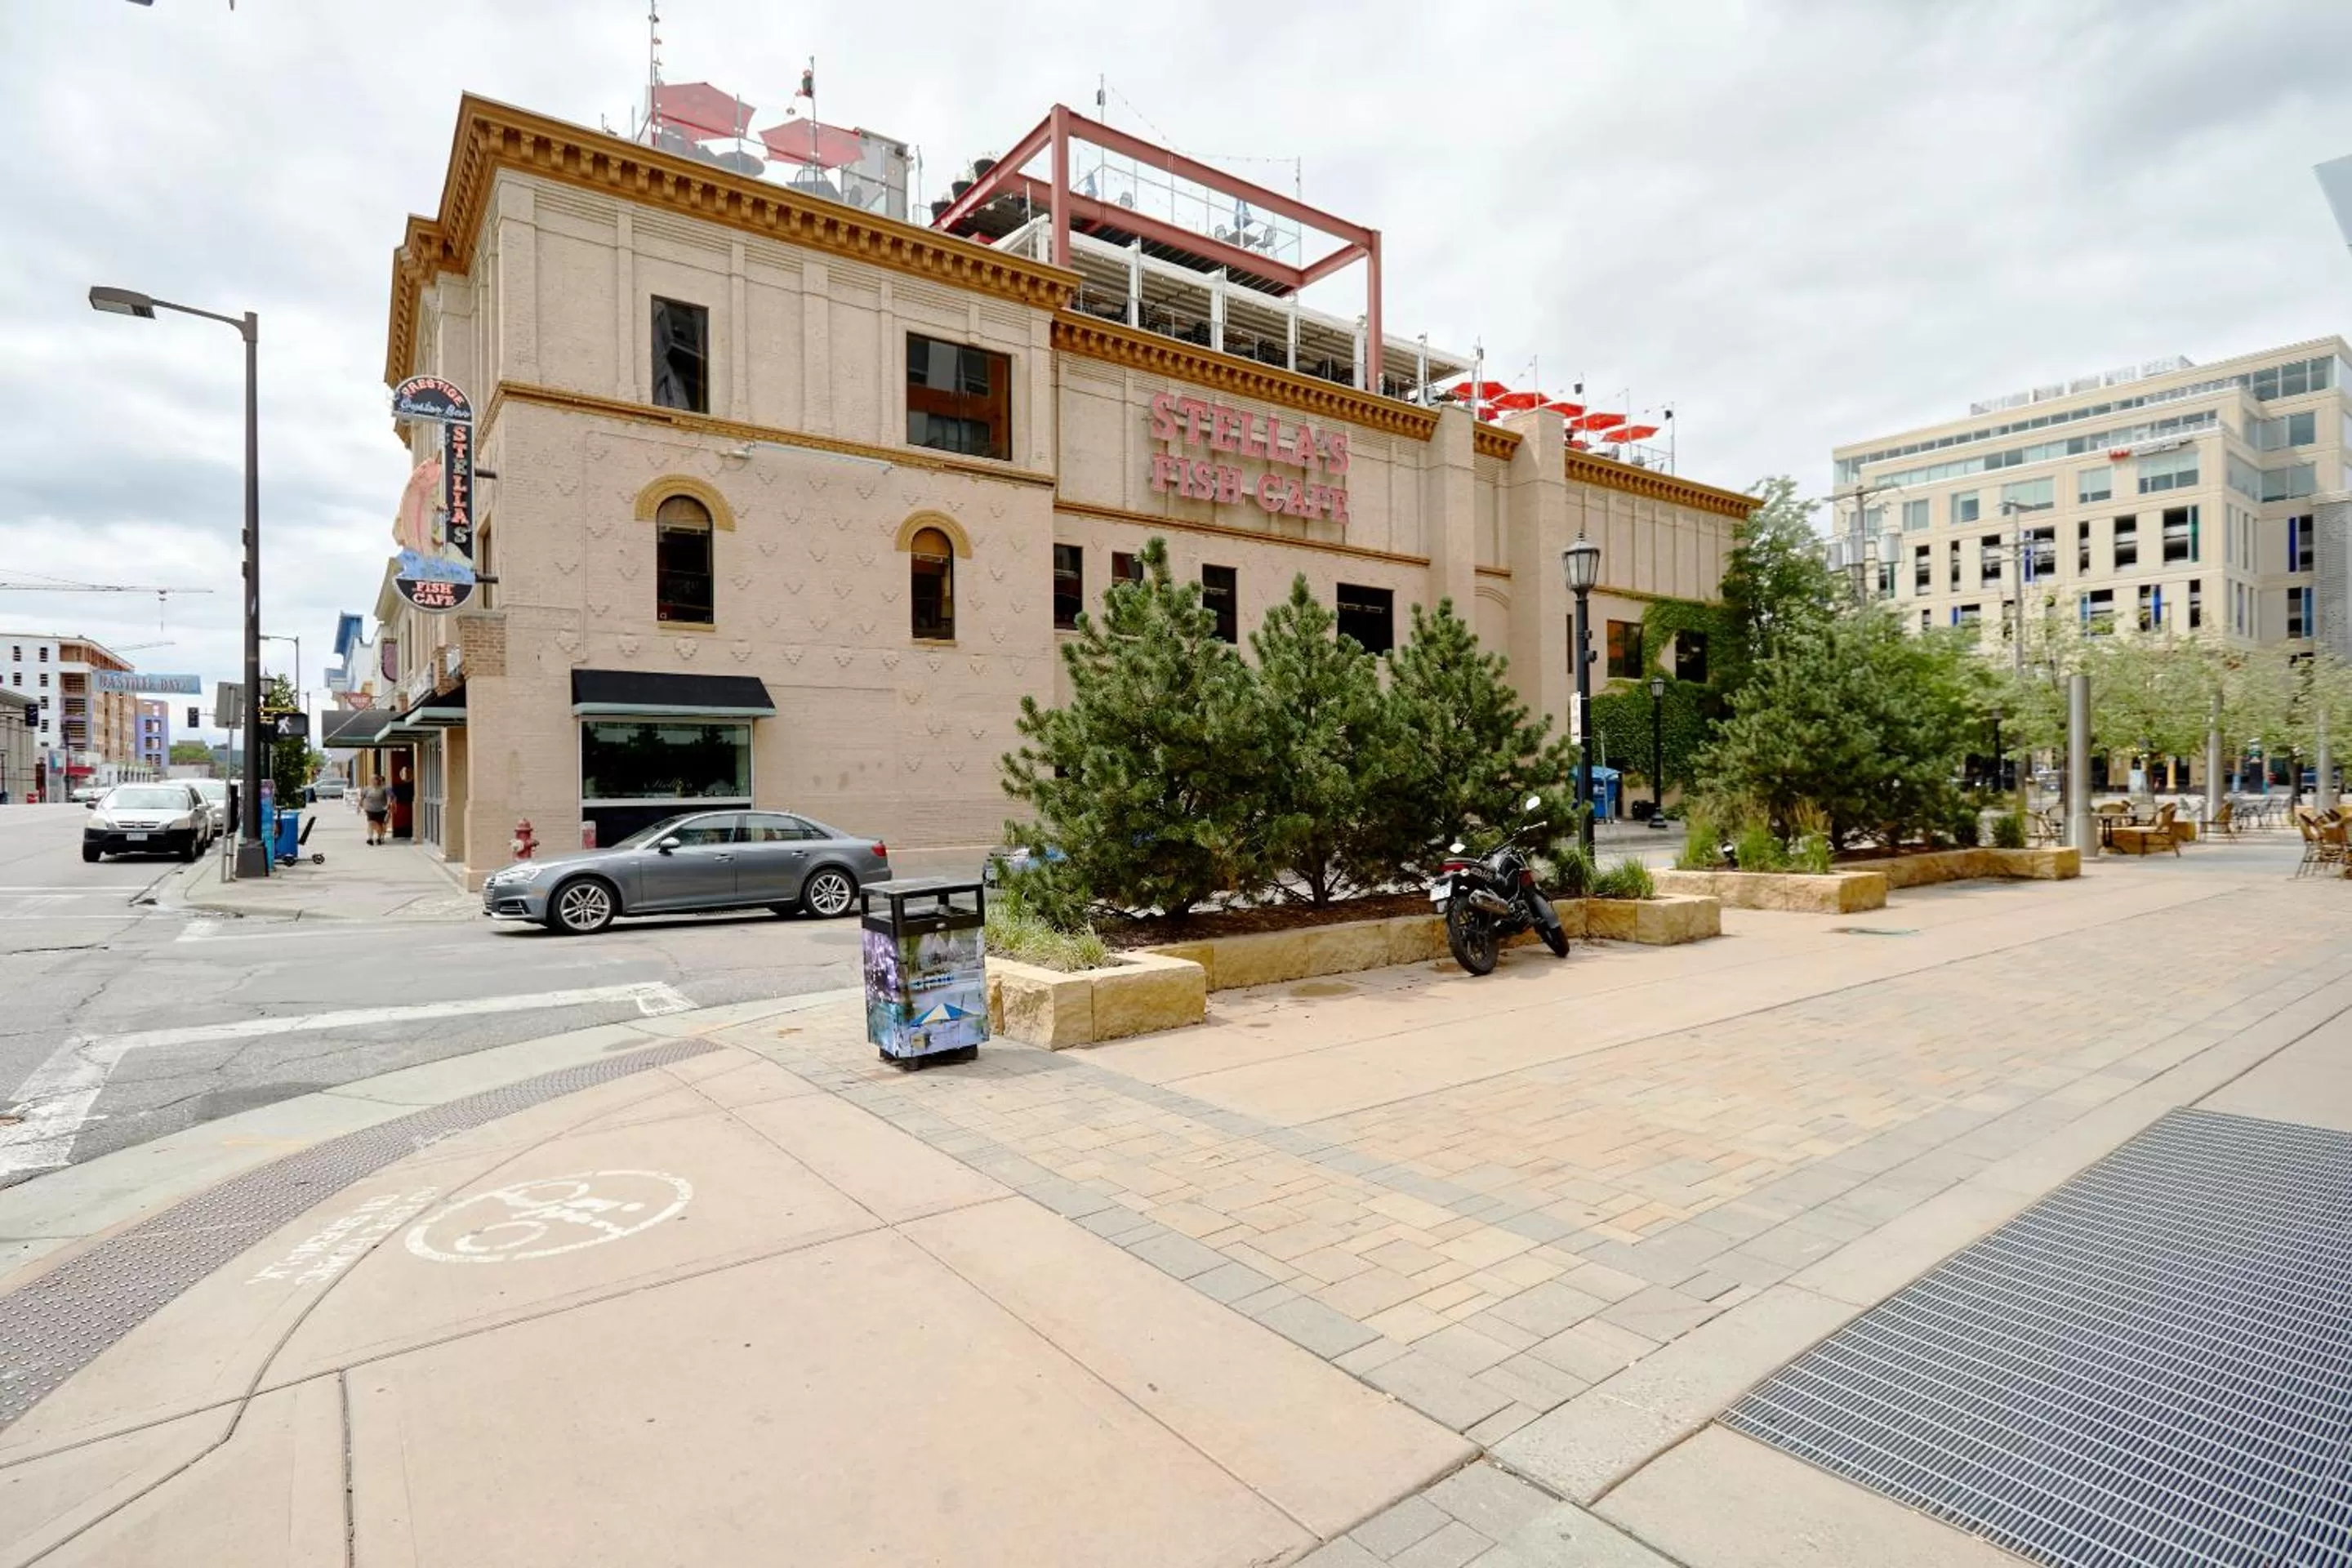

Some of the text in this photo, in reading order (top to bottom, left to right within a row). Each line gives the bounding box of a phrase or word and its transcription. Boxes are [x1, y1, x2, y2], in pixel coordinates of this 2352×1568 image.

[401, 379, 465, 407] PRESTIGE
[400, 398, 471, 418] Oyster Bar
[1151, 392, 1350, 475] STELLA'S
[1151, 452, 1349, 524] FISH CAFE
[412, 581, 456, 606] FISH CAFE
